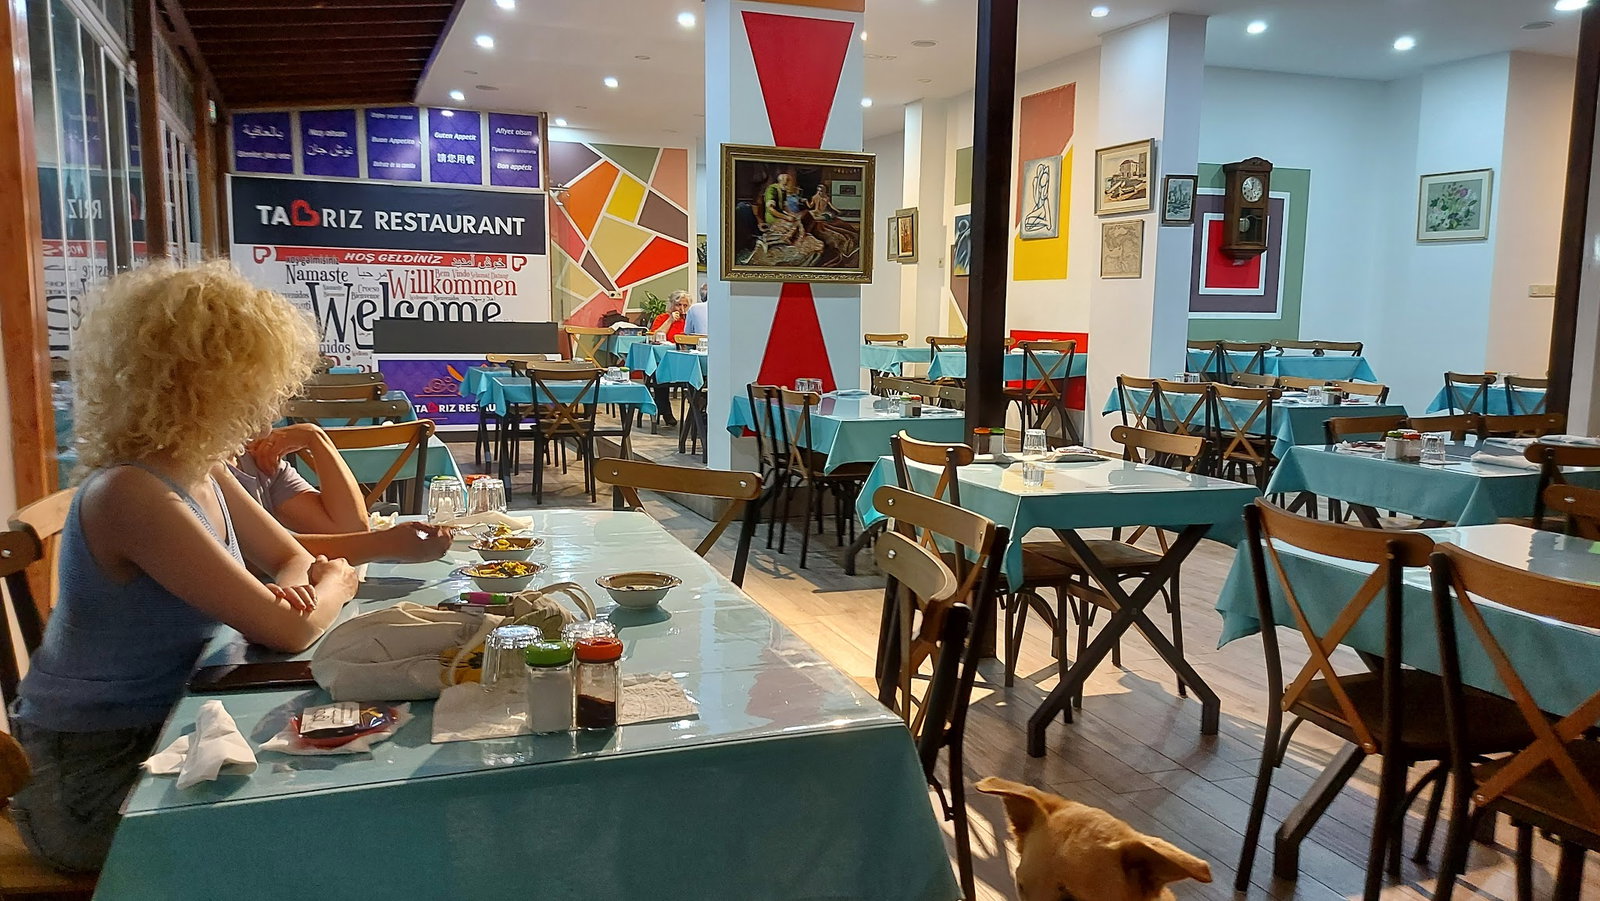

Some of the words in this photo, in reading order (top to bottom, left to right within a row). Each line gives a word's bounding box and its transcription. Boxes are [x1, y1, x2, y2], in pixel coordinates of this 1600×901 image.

[434, 131, 453, 139] Guten
[454, 133, 477, 141] Appetit
[374, 211, 525, 236] RESTAURANT
[344, 252, 375, 263] HOŞ
[377, 253, 443, 264] GELDİNİZ
[285, 264, 349, 284] Namaste
[386, 269, 517, 299] Willkommen
